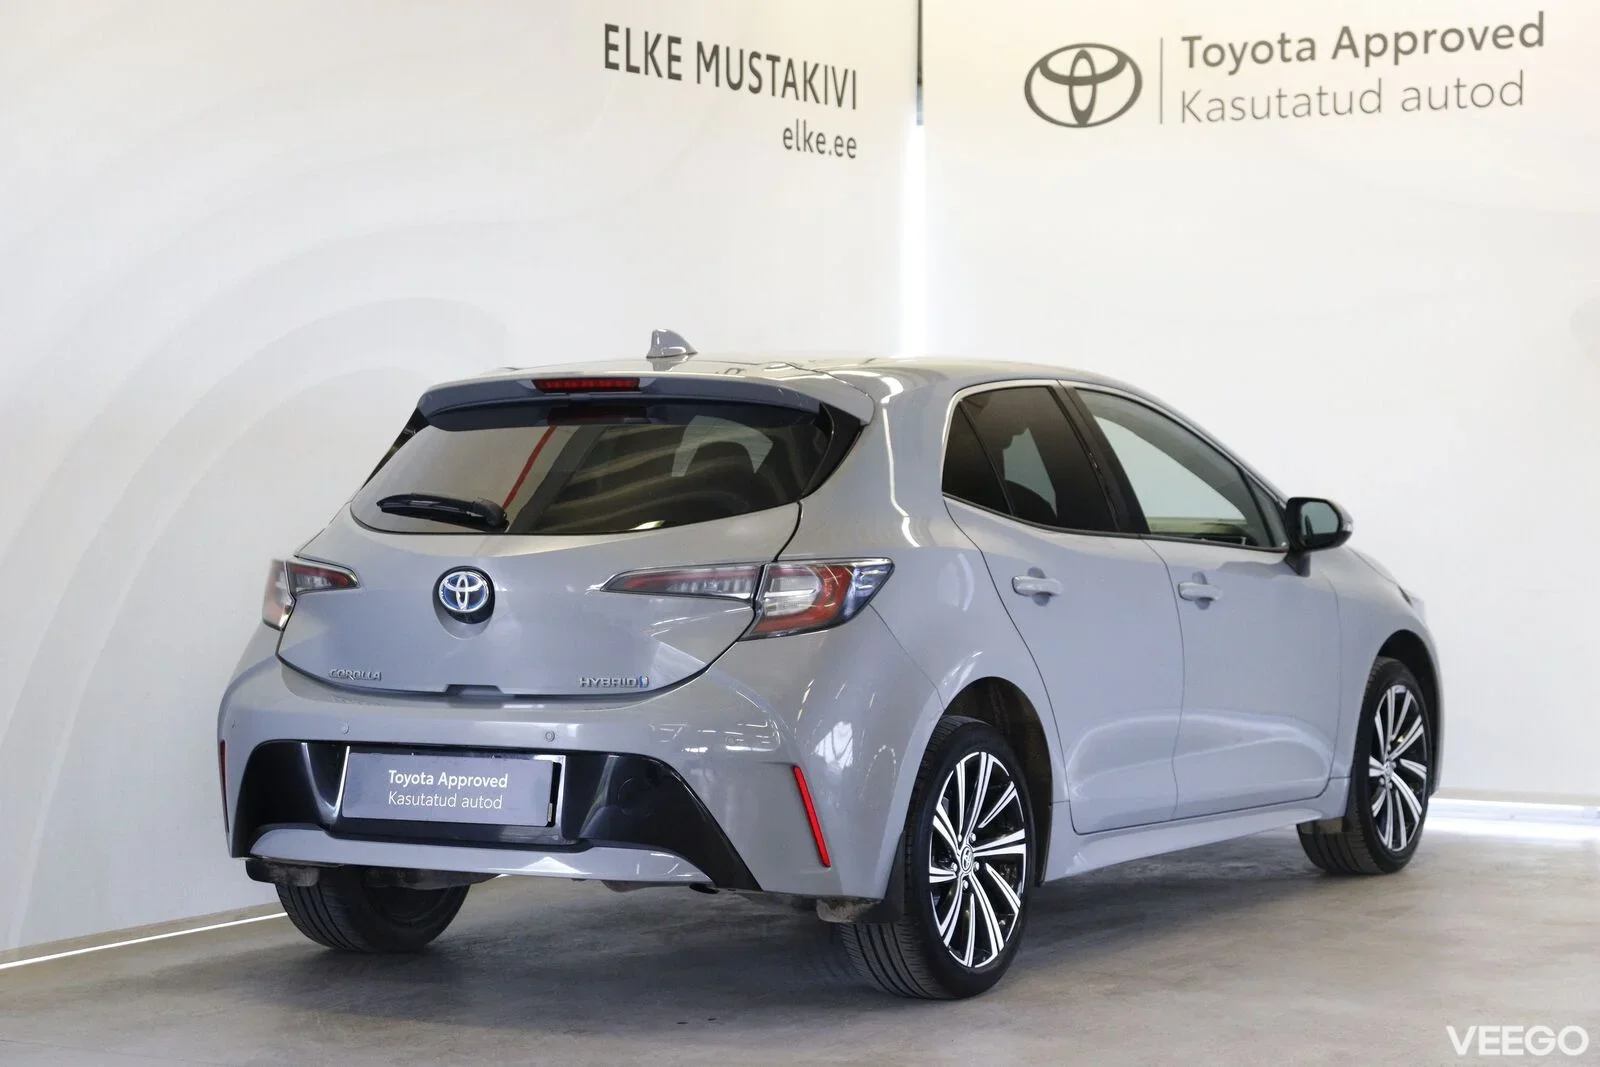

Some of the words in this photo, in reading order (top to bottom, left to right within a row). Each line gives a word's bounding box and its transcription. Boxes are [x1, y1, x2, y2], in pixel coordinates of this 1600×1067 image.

[1181, 32, 1316, 76] Toyota
[1331, 10, 1544, 67] Approved
[604, 23, 683, 81] ELKE
[696, 40, 857, 110] MUSTAKIVI
[1181, 78, 1382, 124] Kasutatud
[1400, 69, 1524, 112] autod
[782, 118, 857, 159] elke.ee
[329, 668, 382, 681] COROLLA
[579, 677, 638, 688] HYBRID
[388, 769, 434, 788] Toyota
[437, 771, 509, 790] Approved
[388, 790, 457, 808] Kasutatud
[461, 794, 503, 809] autod
